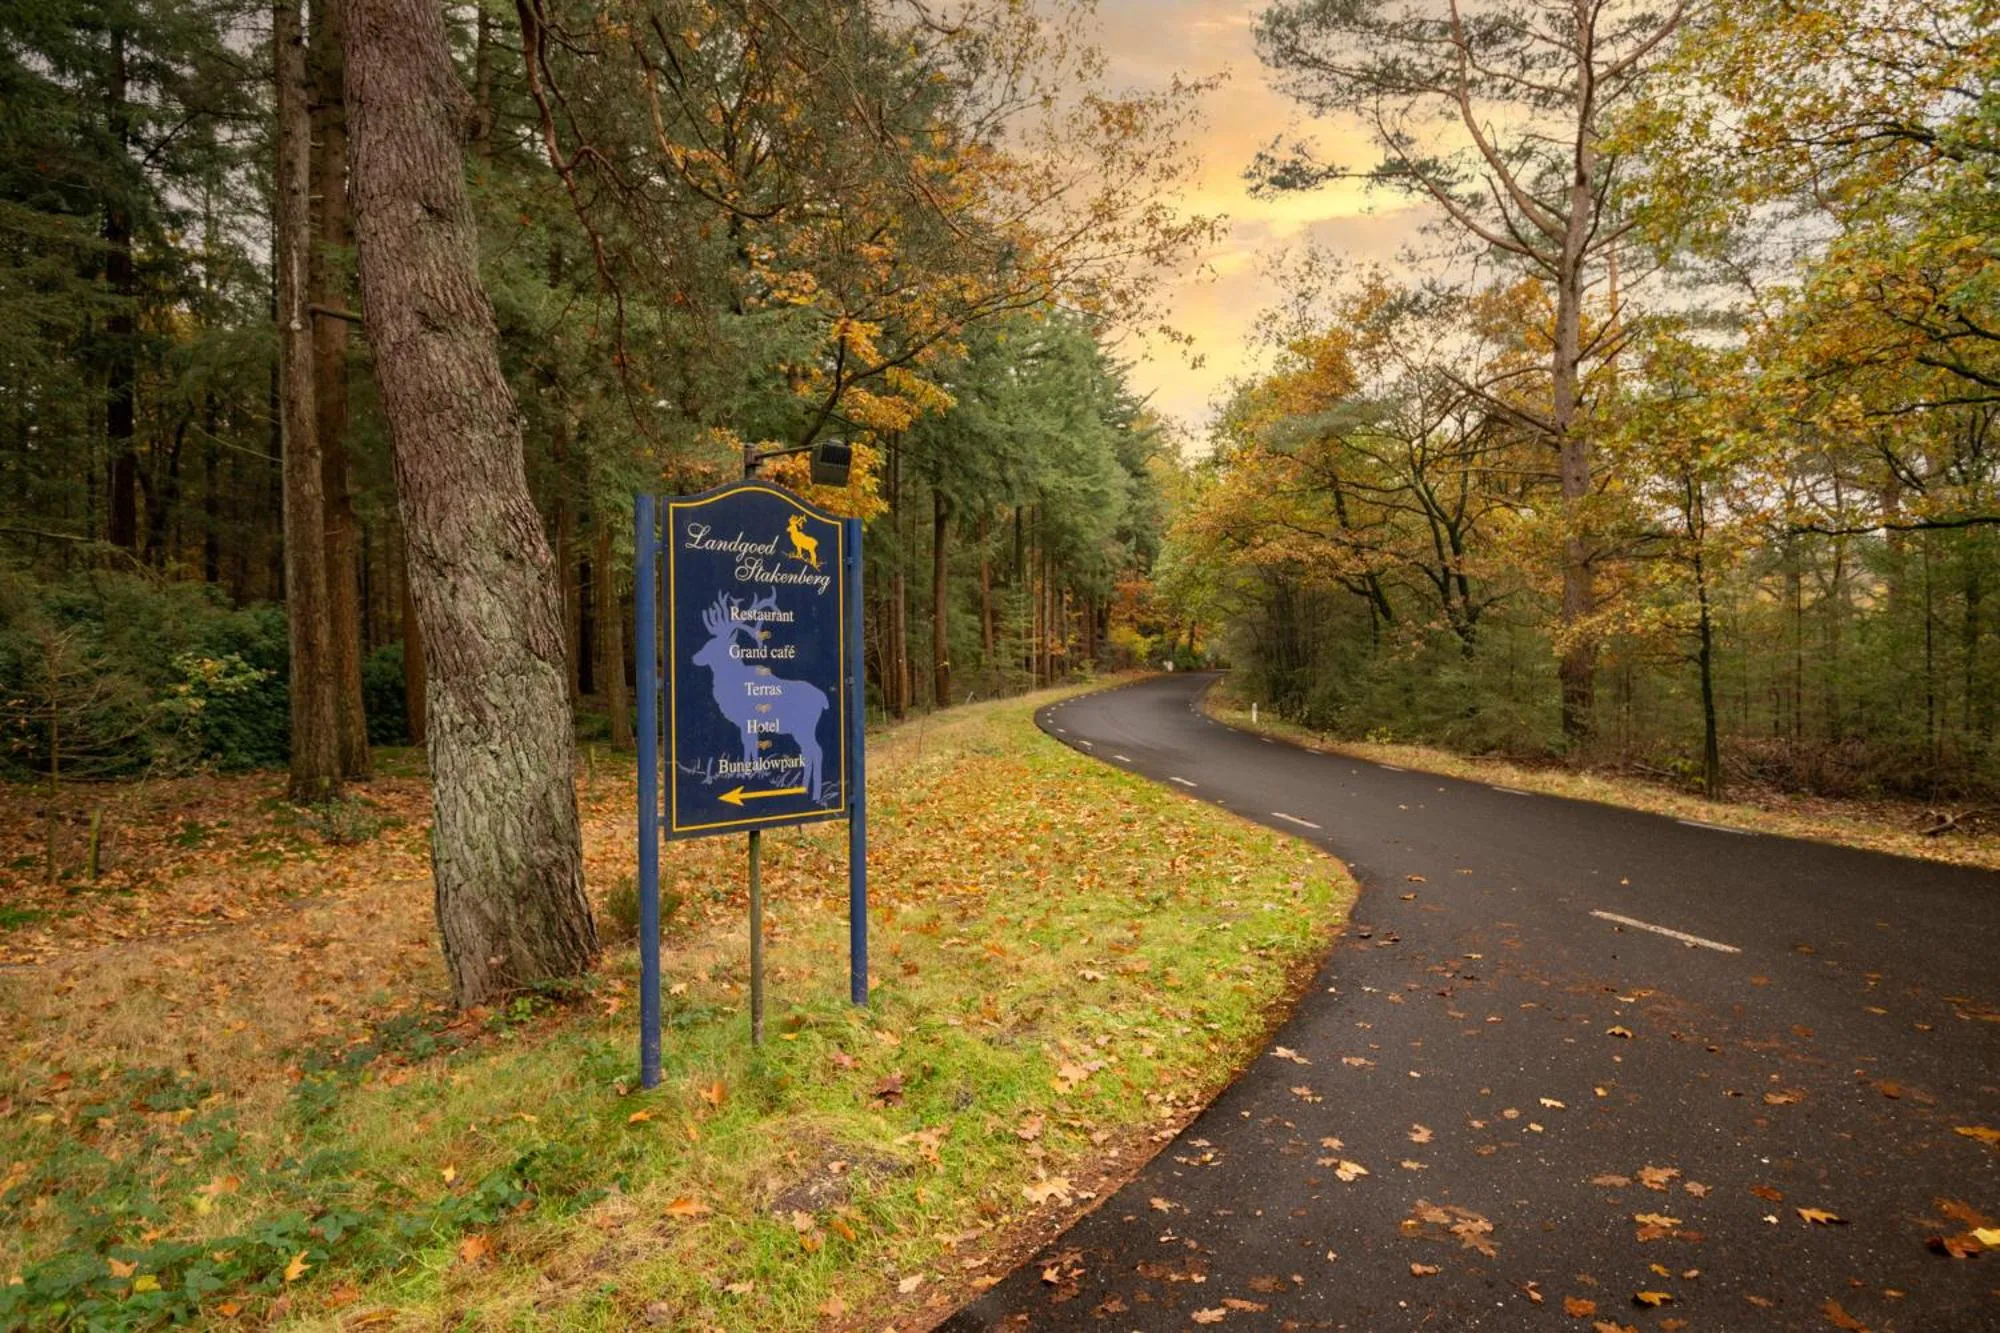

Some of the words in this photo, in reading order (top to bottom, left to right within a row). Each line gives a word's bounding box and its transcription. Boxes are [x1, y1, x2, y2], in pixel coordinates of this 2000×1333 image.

[685, 522, 780, 562] Landgoed
[734, 557, 831, 595] Stakenberg
[730, 606, 795, 623] Restaurant
[729, 644, 768, 659] Grand
[770, 644, 795, 659] café
[744, 682, 782, 697] Terras
[747, 719, 780, 734] Hotel
[719, 754, 806, 776] Bungalowpark
